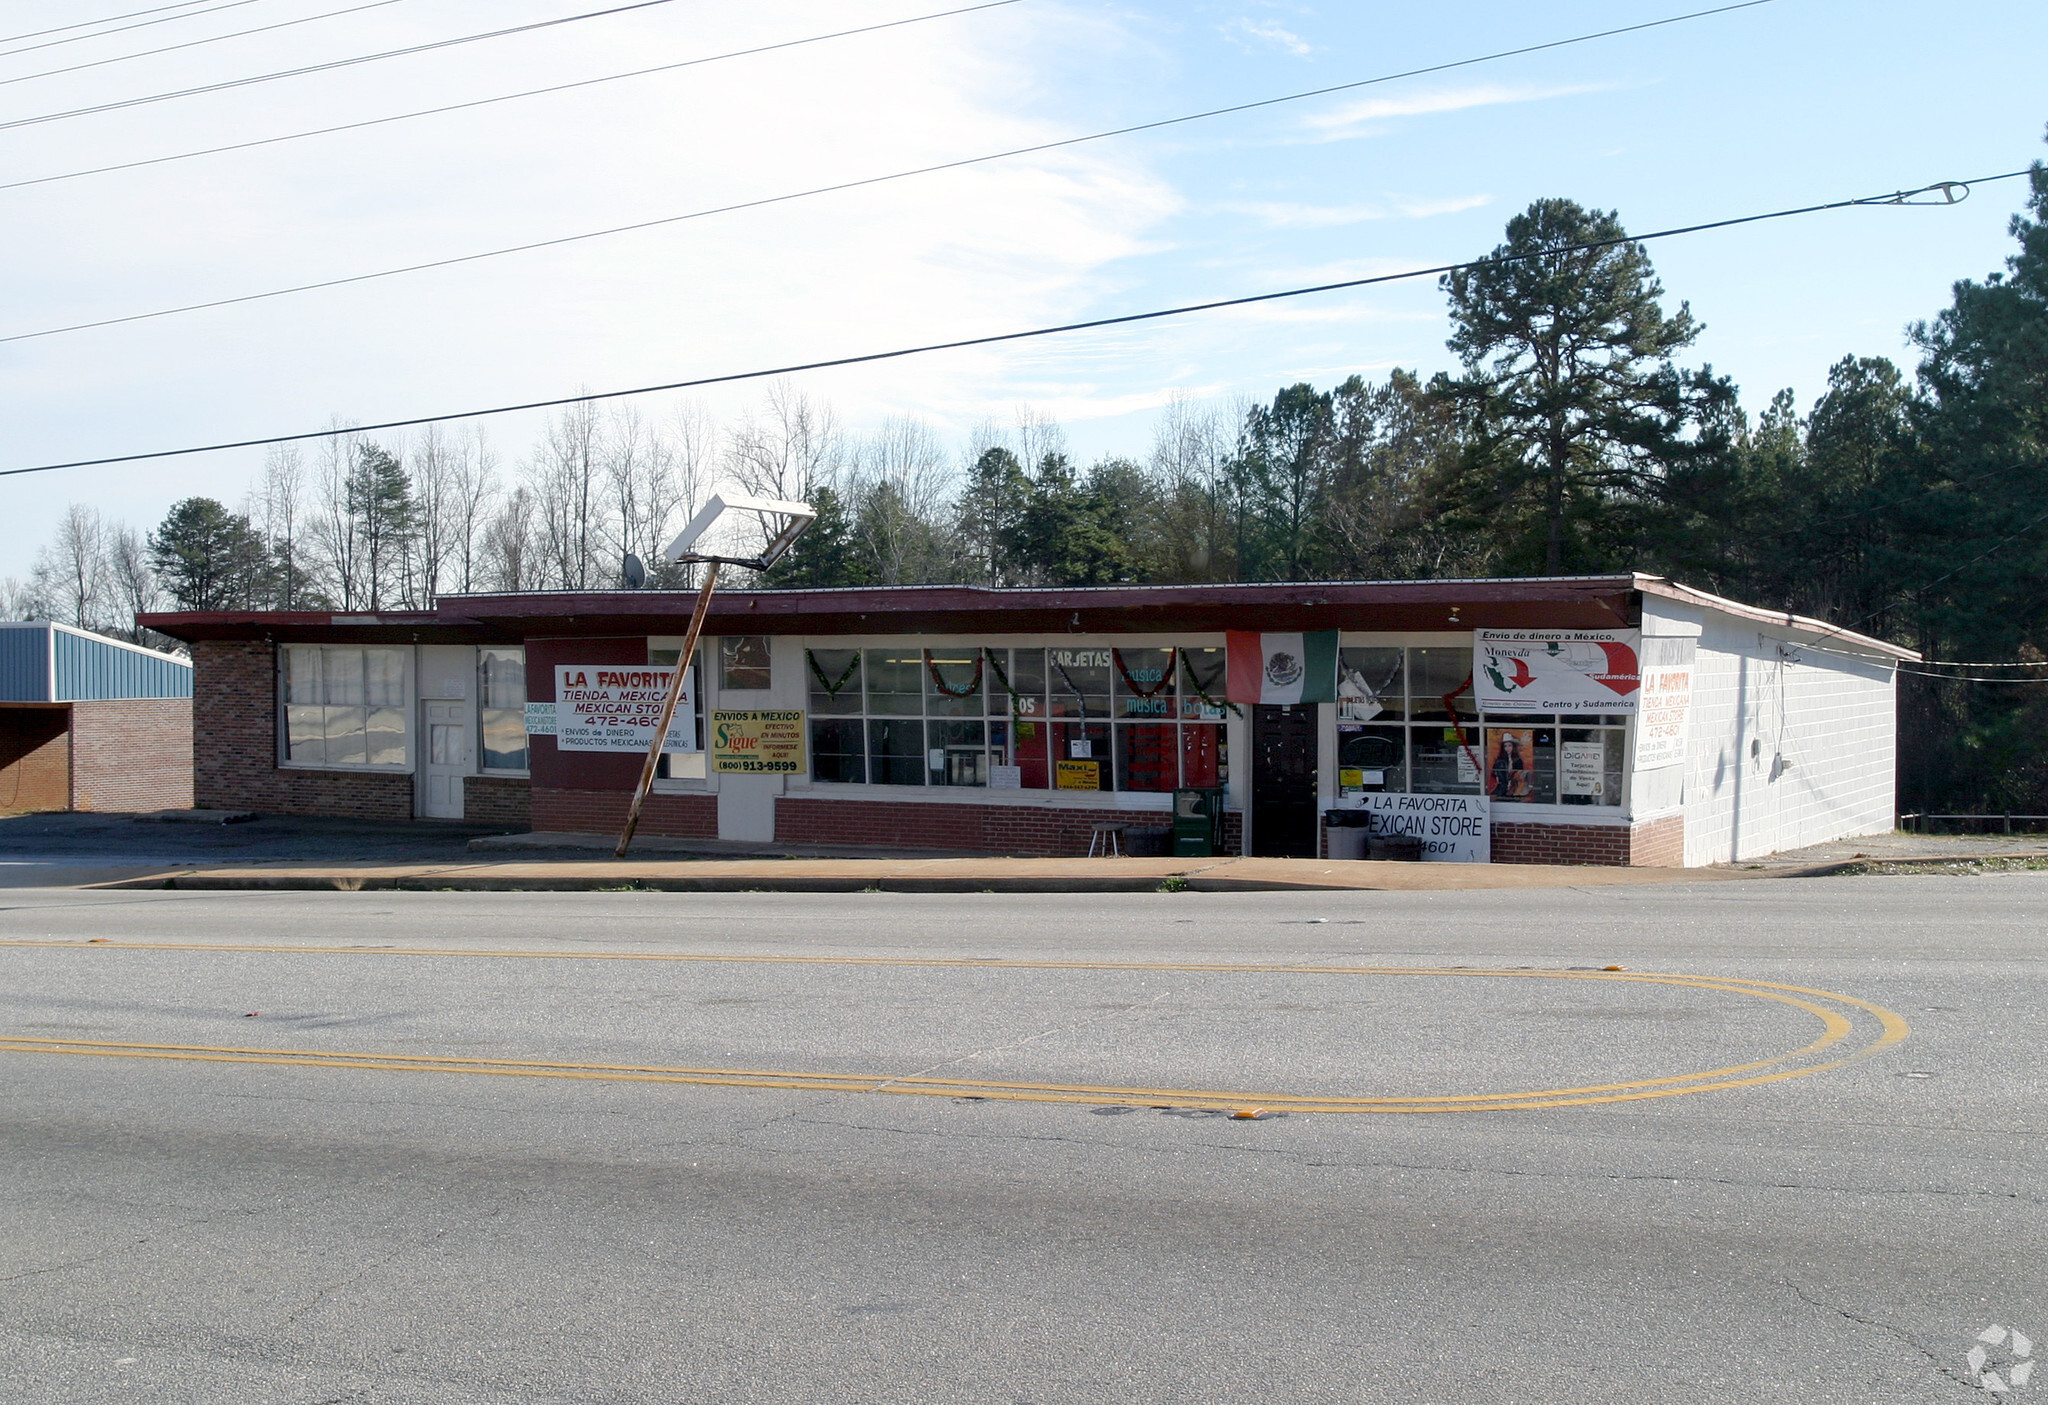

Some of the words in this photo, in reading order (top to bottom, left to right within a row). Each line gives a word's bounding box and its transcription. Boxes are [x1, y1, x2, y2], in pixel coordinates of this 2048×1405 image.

[1513, 631, 1526, 640] de
[1529, 631, 1561, 641] dinero
[566, 671, 588, 688] LA
[1645, 673, 1655, 694] LA
[1660, 672, 1689, 693] FAVORITA
[563, 690, 610, 702] TIENDA
[619, 691, 688, 702] MEXICAA
[1643, 696, 1662, 708] TIENDA
[1665, 694, 1690, 707] MEXICANA
[575, 704, 630, 714] MEXICAN
[636, 704, 677, 715] STO
[1127, 697, 1167, 713] musica
[1543, 701, 1572, 709] Centro
[1574, 702, 1580, 710] y
[1583, 700, 1634, 708] Sudamerica
[585, 716, 660, 727] 472-460
[714, 713, 748, 721] ENVIOS
[751, 713, 758, 721] A
[761, 712, 800, 721] MEXICO
[1647, 711, 1668, 723] MEXICAN
[525, 725, 557, 733] 472-4601
[1649, 725, 1680, 738] 472-4601
[565, 739, 608, 747] PRODUCTOS
[715, 723, 758, 754] Sigue
[719, 761, 741, 769] (800)
[743, 761, 797, 771] 913-9599
[1374, 796, 1393, 810] LA
[1398, 797, 1467, 812] FAVORITA
[1368, 814, 1426, 835] EXICAN
[1430, 815, 1483, 837] STORE
[1420, 841, 1456, 854] 4601
